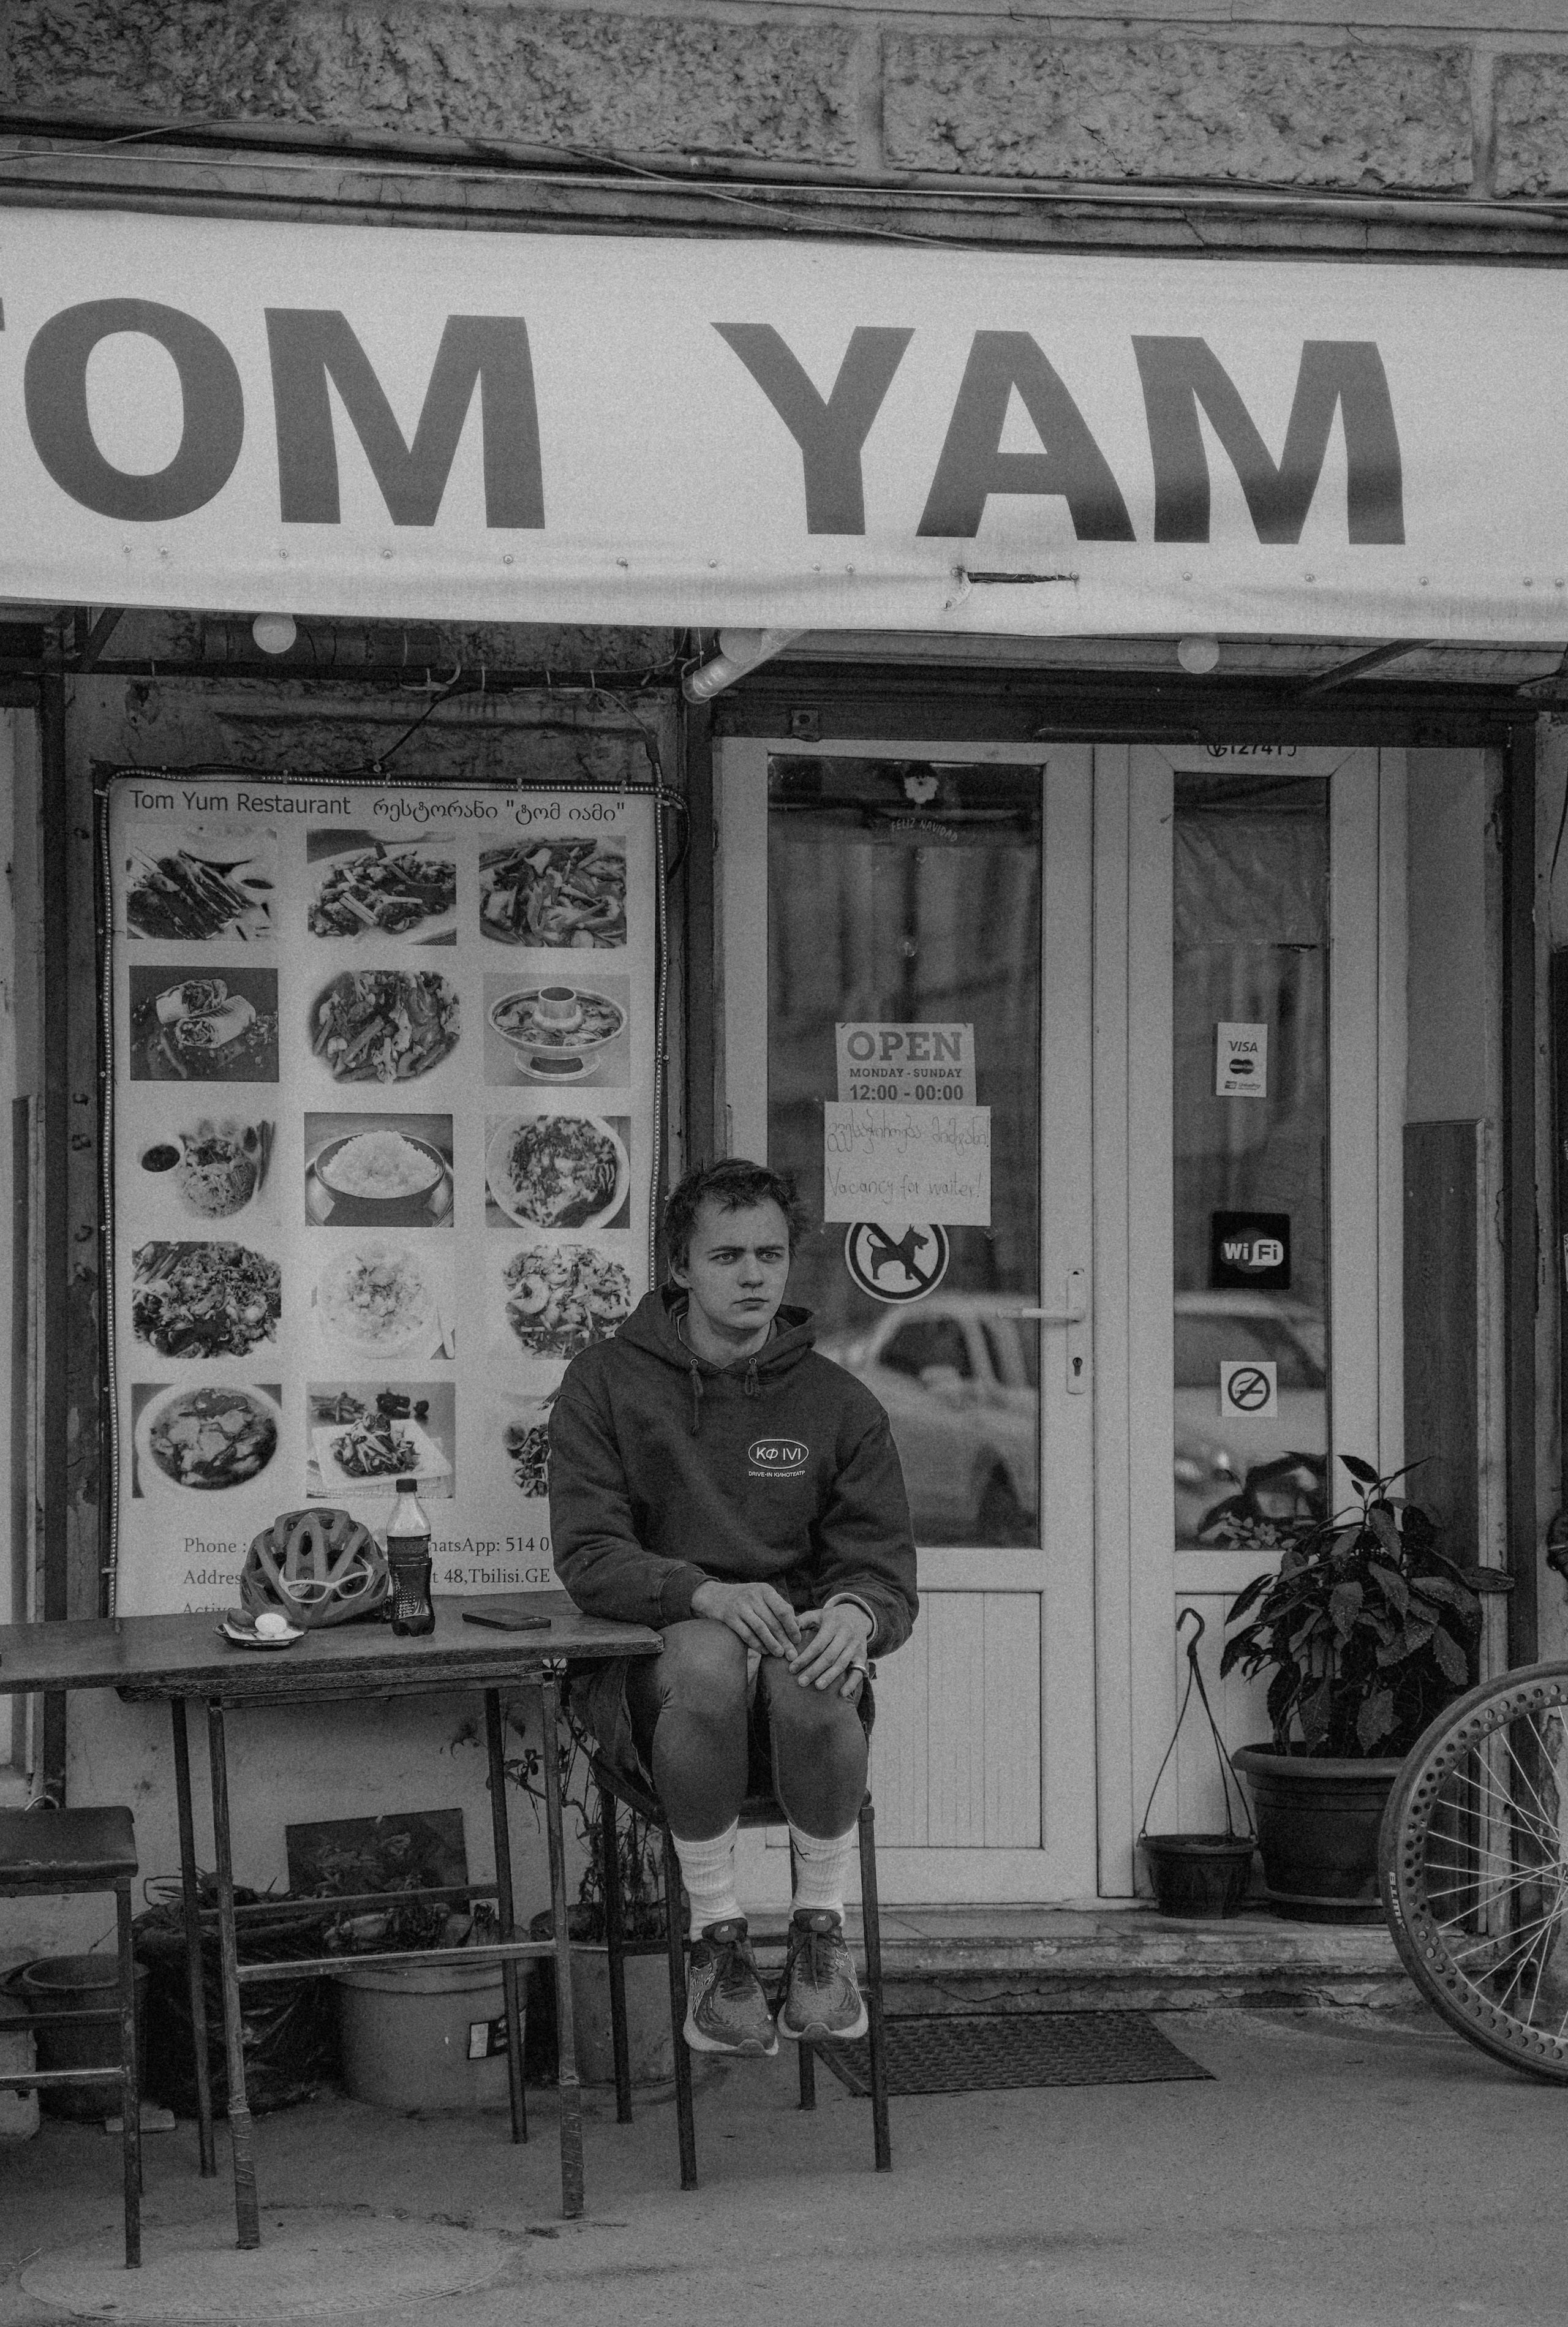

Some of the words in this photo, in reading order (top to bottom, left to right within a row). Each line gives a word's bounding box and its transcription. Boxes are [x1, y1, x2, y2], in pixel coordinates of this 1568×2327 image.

[0, 296, 545, 530] OM
[710, 321, 1406, 545] YAM
[129, 790, 174, 810] Tom
[183, 792, 228, 812] Yum
[238, 793, 352, 815] Restaurant
[373, 798, 498, 822] რესტორანი
[891, 817, 916, 832] FELIZ
[919, 819, 958, 842] NAVIDAD
[847, 1030, 962, 1062] OPEN
[1228, 1040, 1258, 1052] VISA
[850, 1068, 904, 1077] MONDAY
[913, 1068, 962, 1077] SUNDAY
[850, 1084, 897, 1101] 12:00
[915, 1084, 964, 1101] 00:00
[827, 1167, 894, 1204] Vacancy
[900, 1174, 919, 1200] for
[929, 1172, 982, 1198] waiter!
[184, 1537, 237, 1553] Phone
[431, 1537, 500, 1556] atsApp:
[506, 1537, 535, 1552] 514
[183, 1569, 241, 1585] Addres
